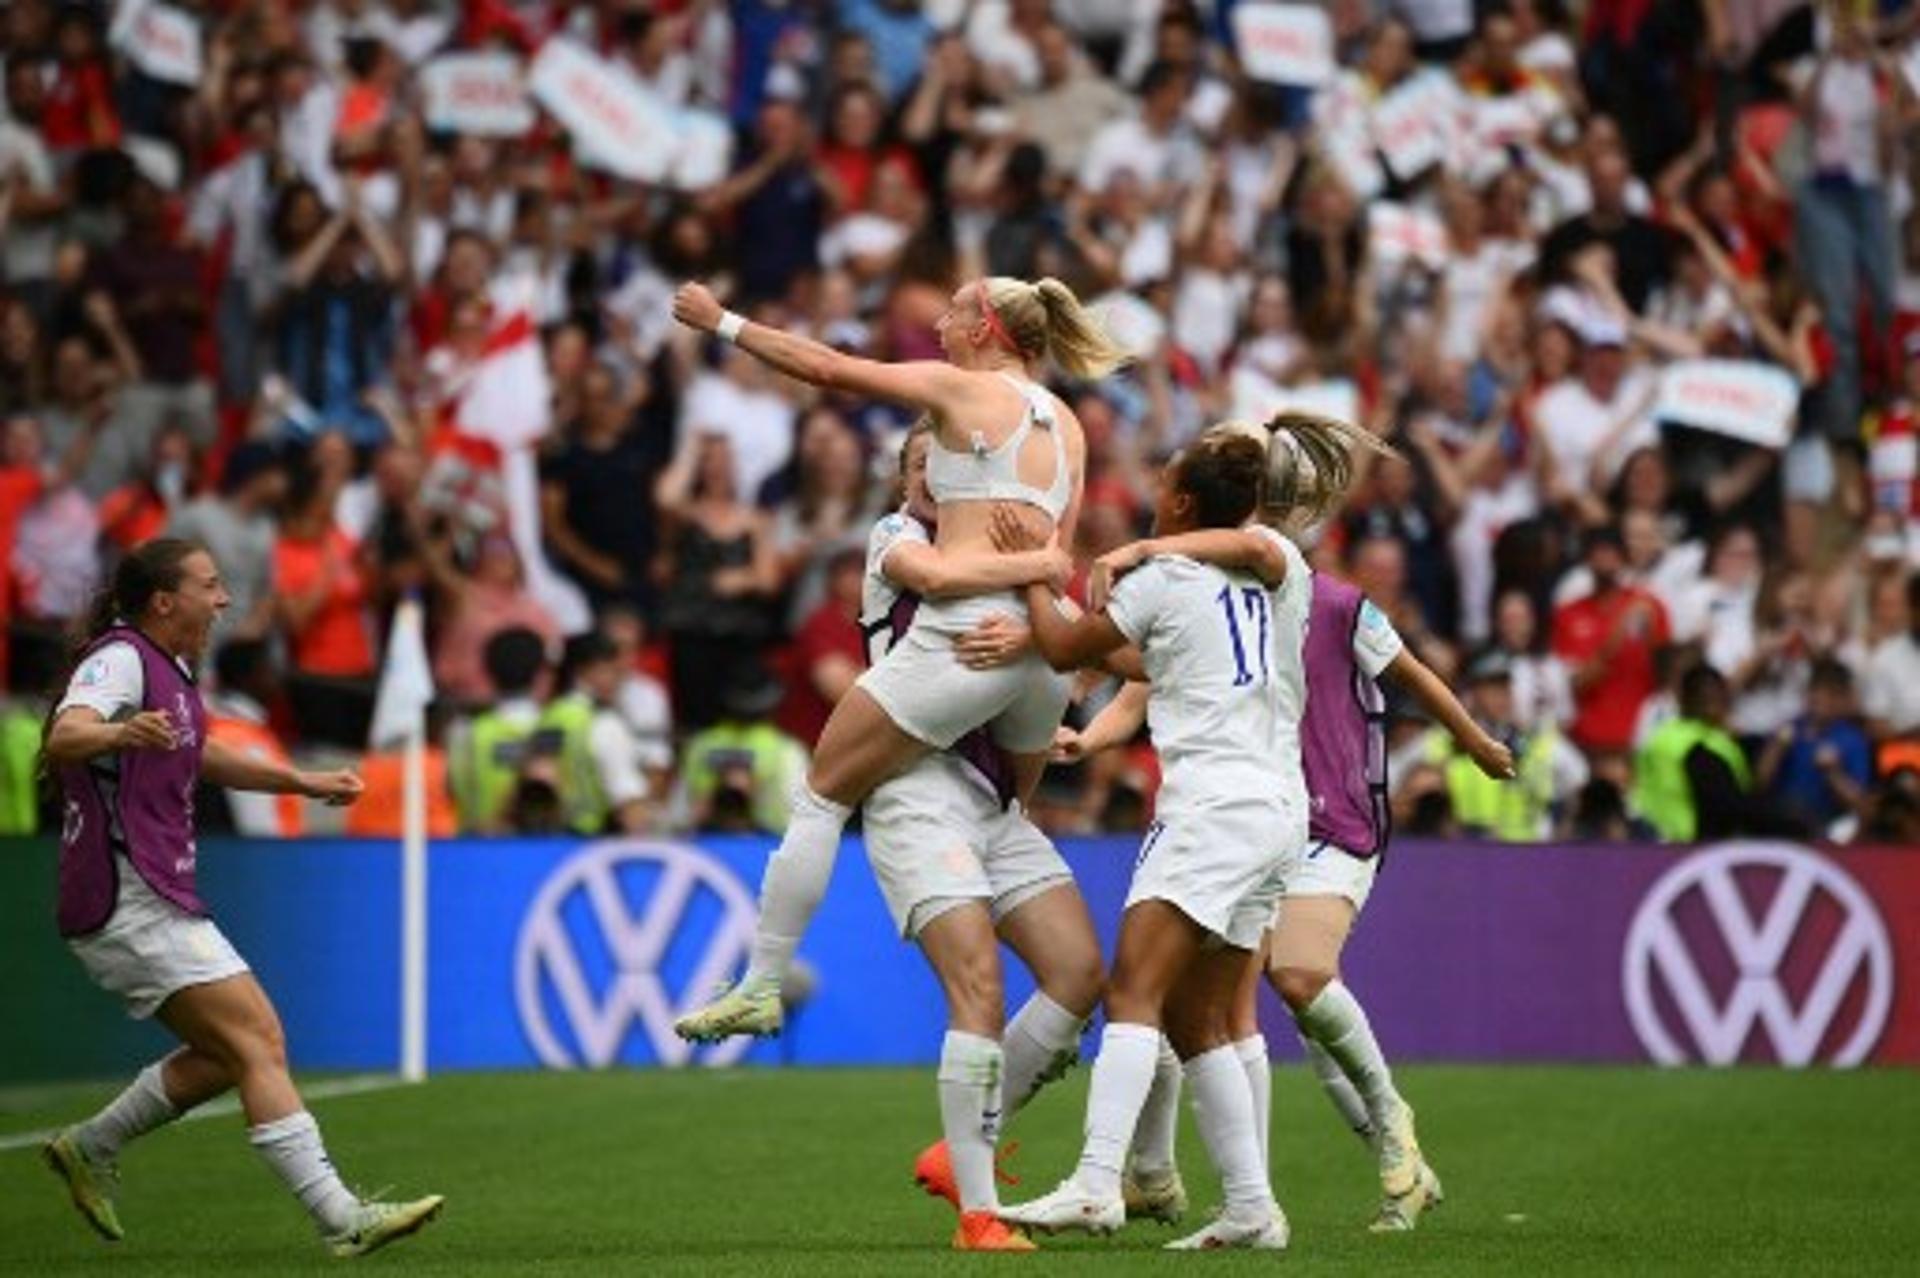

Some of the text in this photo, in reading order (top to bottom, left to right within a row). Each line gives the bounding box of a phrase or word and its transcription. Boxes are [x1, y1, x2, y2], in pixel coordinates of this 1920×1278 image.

[1214, 583, 1268, 687] 17
[517, 841, 759, 1067] VW
[1624, 841, 1893, 1067] VW
